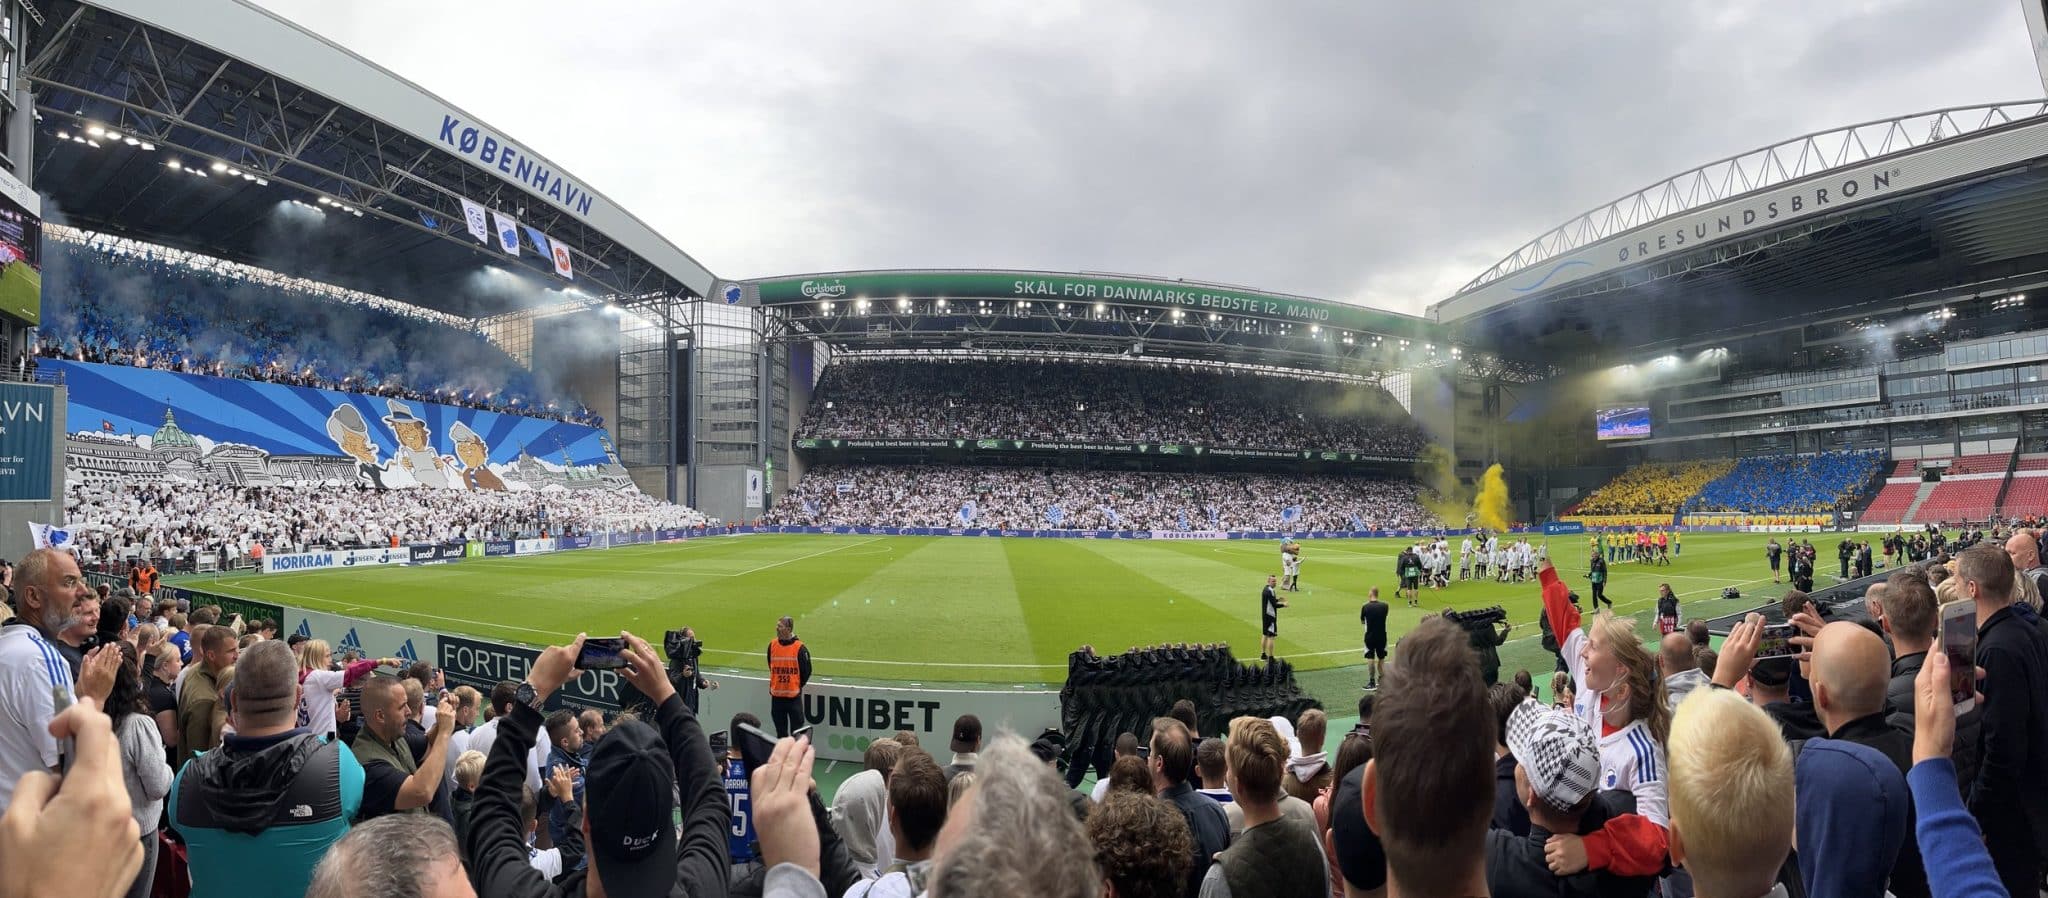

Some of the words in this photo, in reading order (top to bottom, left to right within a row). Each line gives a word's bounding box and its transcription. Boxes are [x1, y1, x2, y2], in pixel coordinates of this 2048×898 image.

[439, 115, 593, 217] KØBENHAVN
[800, 279, 846, 299] Carlsberg
[1014, 280, 1057, 296] SKÅL
[1064, 283, 1096, 297] FOR
[1103, 285, 1195, 305] DANMARKS
[1201, 294, 1258, 312] BEDSTE
[1264, 301, 1281, 315] 12.
[1287, 304, 1329, 321] MAND
[0, 401, 43, 422] VN
[847, 440, 874, 448] Probably
[1031, 442, 1058, 450] Probably
[272, 553, 333, 571] HØRKRAM
[803, 694, 941, 733] UNIBET
